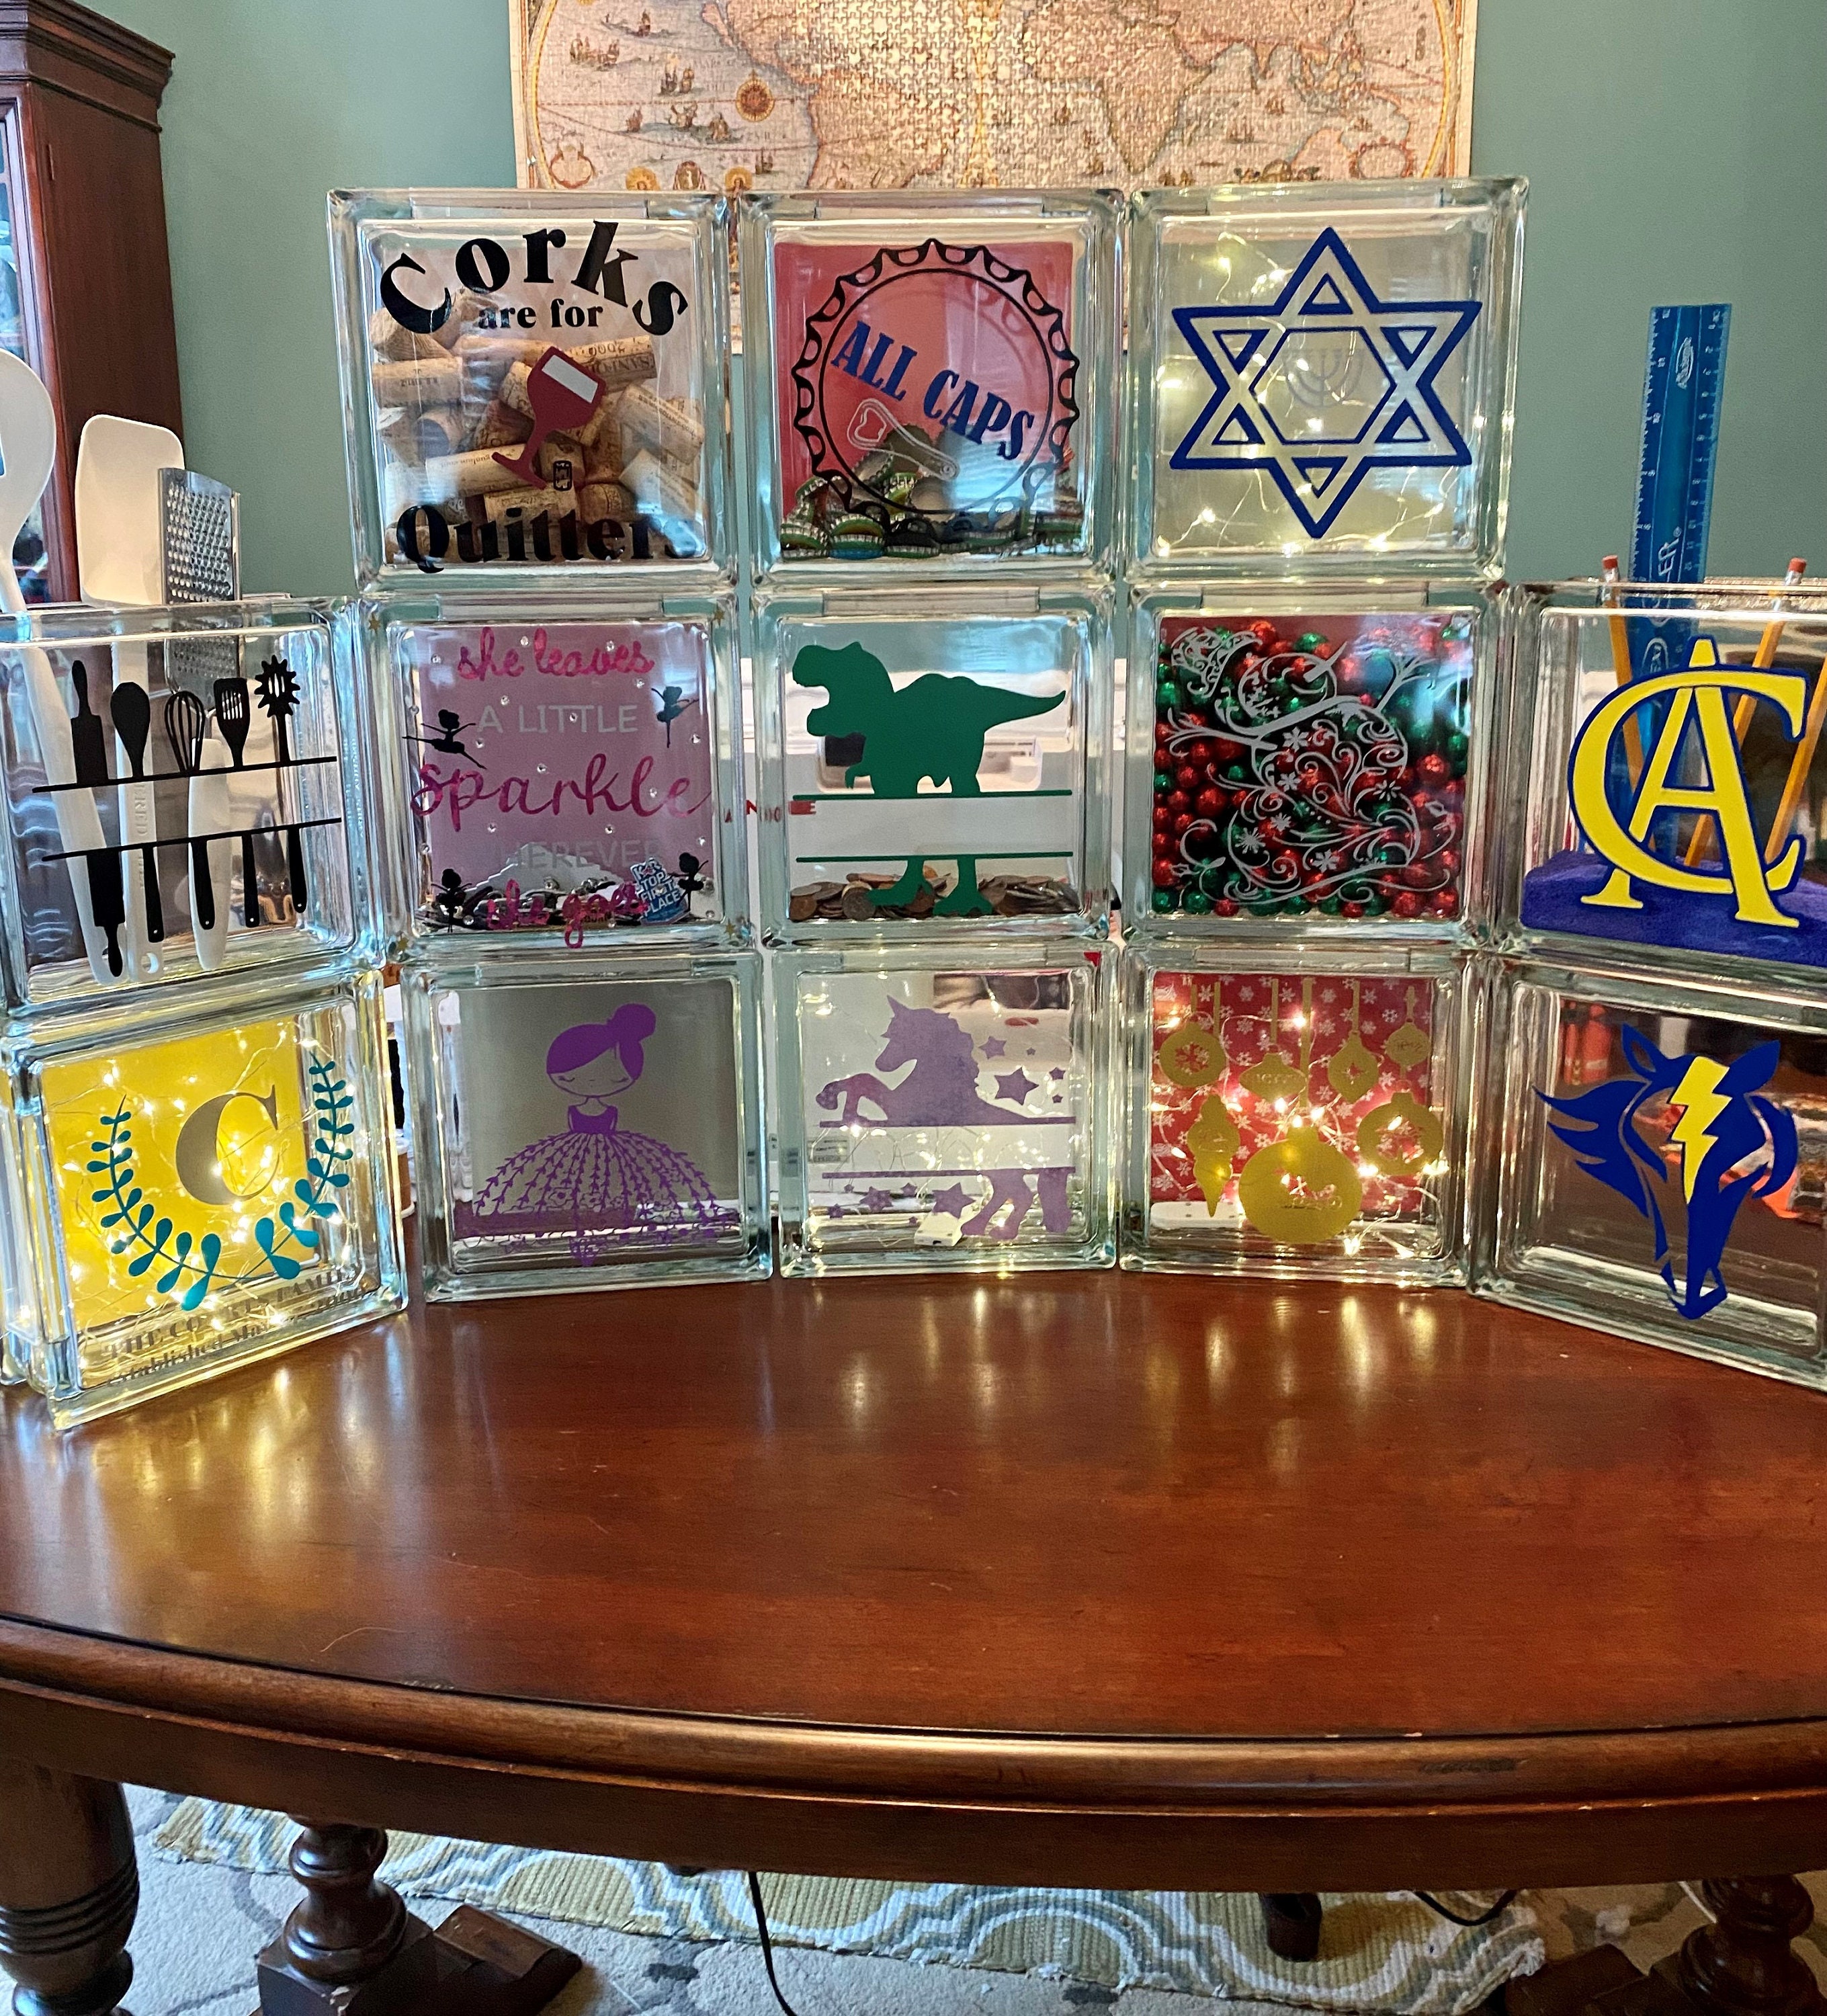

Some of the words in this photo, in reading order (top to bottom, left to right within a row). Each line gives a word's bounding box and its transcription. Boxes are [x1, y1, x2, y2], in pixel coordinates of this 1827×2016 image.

[380, 220, 688, 335] Corks
[478, 304, 536, 328] are
[550, 299, 603, 328] for
[831, 321, 917, 403] ALL
[923, 369, 1035, 460] CAPS
[458, 626, 524, 681] she
[534, 627, 656, 677] leaves
[478, 705, 504, 733] A
[518, 704, 638, 734] LITTLE
[411, 753, 712, 832] sparkle
[640, 878, 675, 901] FIRT
[641, 871, 665, 891] TOP
